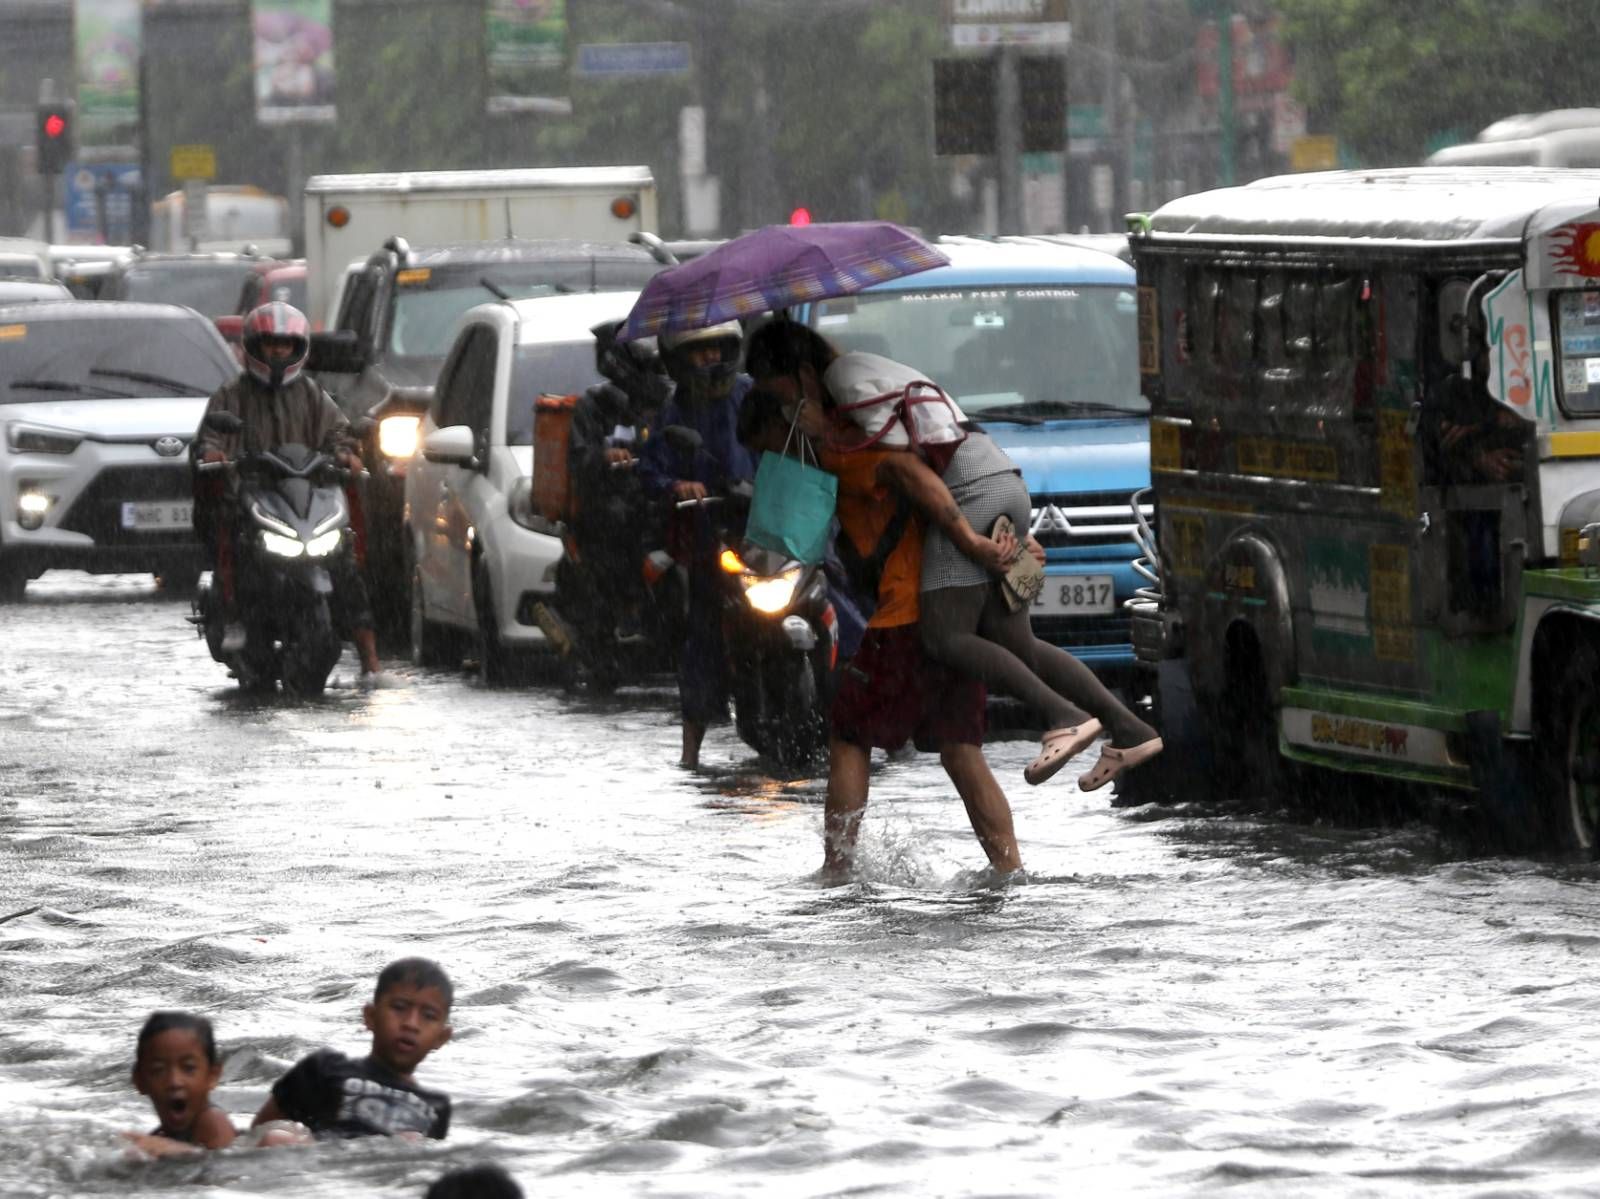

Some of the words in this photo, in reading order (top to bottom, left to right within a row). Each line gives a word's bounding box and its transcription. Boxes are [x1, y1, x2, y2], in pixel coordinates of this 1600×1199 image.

[901, 292, 962, 302] MALAKAI
[971, 290, 1009, 299] PEST
[1016, 288, 1080, 298] CONTROL
[1060, 584, 1111, 606] 8817
